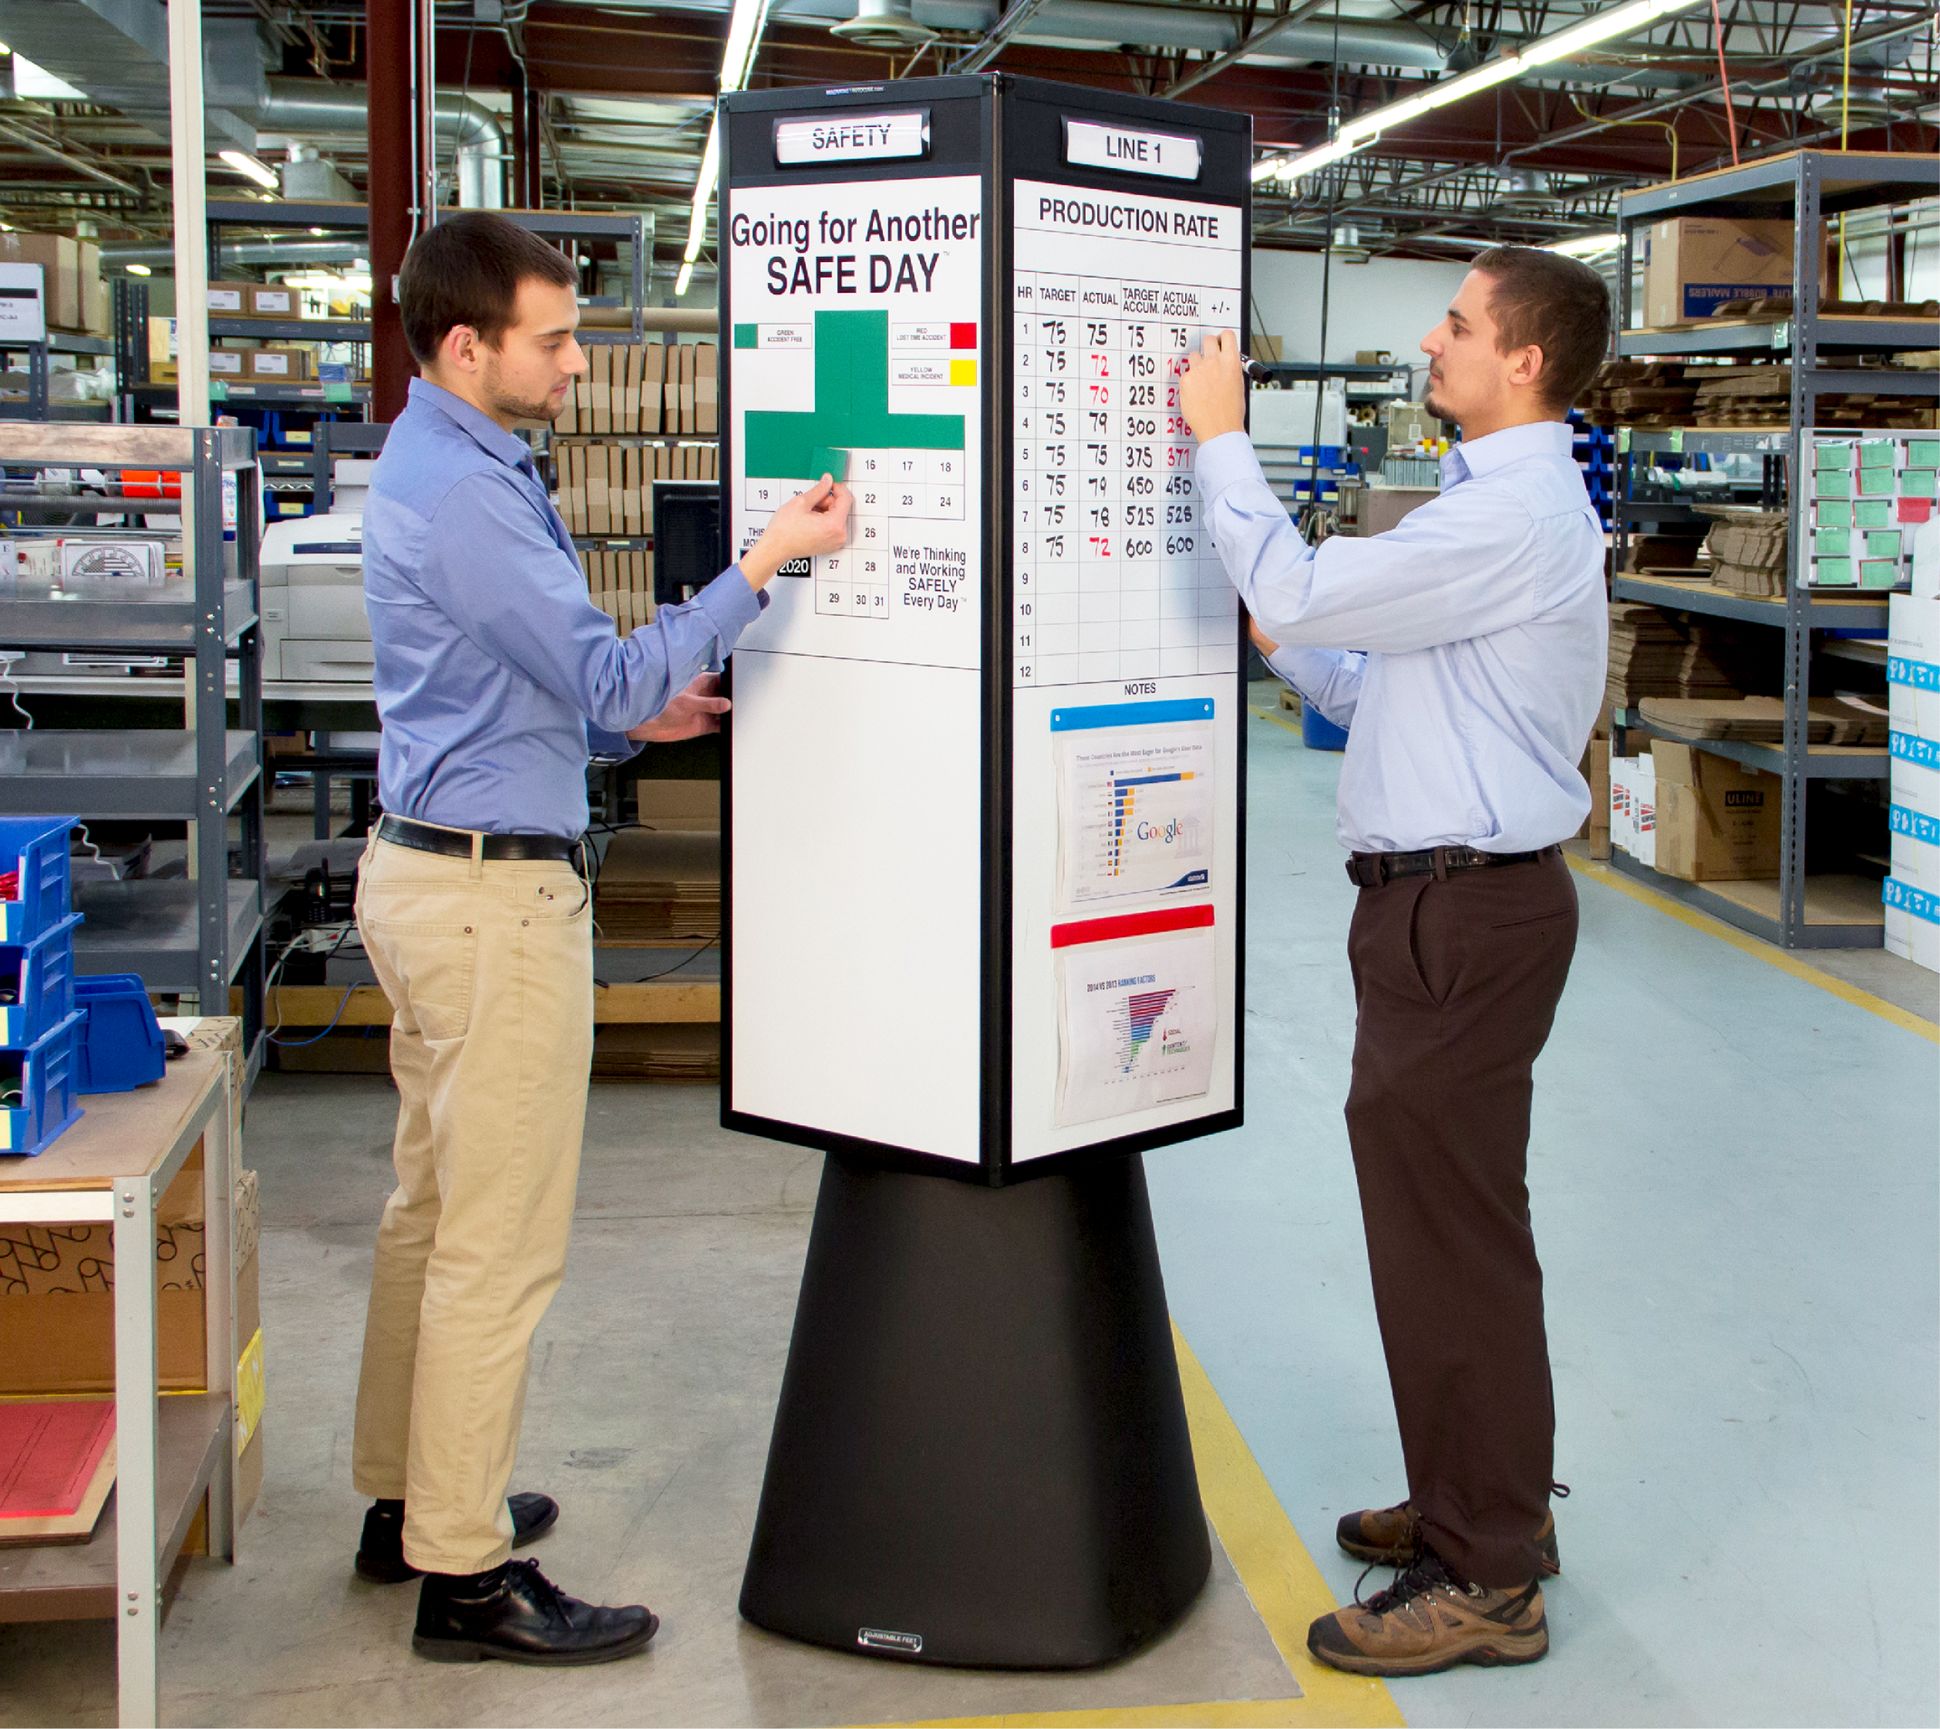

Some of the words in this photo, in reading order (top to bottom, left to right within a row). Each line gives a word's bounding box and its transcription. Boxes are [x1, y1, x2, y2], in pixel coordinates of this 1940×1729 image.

[812, 123, 891, 150] SAFETY
[1106, 136, 1148, 162] LINE
[1154, 143, 1162, 163] 1
[1039, 198, 1168, 234] PRODUCTION
[1174, 213, 1219, 239] RATE
[731, 213, 810, 253] Going
[819, 210, 857, 244] for
[865, 206, 980, 242] Another
[767, 255, 856, 295] SAFE
[869, 252, 939, 294] DAY
[1017, 286, 1033, 299] HR
[1040, 288, 1076, 302] TARGET
[1082, 291, 1118, 305] ACTUAL
[1122, 288, 1160, 301] TARGET
[1163, 291, 1199, 305] ACTUAL
[1688, 287, 1731, 298] MAILERS
[1122, 301, 1160, 314] ACCUM.
[1163, 304, 1199, 318] ACCUM.
[1023, 324, 1028, 334] 1
[1043, 321, 1066, 345] 75
[1087, 323, 1108, 346] 75
[1128, 325, 1145, 348] 75
[1170, 327, 1187, 348] 75
[1022, 355, 1029, 366] 2
[1046, 350, 1066, 373] 75
[1091, 354, 1109, 377] 72
[1128, 354, 1155, 378] 150
[1022, 386, 1029, 397] 3
[1045, 382, 1065, 403] 75
[1089, 385, 1109, 404] 70
[1129, 385, 1156, 406] 225
[1022, 417, 1029, 428] 4
[1046, 413, 1066, 435] 75
[1089, 411, 1108, 435] 79
[1127, 416, 1156, 437] 300
[1022, 448, 1029, 460] 5
[1046, 445, 1065, 466] 75
[1087, 444, 1108, 466] 75
[1126, 447, 1153, 468] 375
[1167, 447, 1190, 468] 371
[865, 459, 876, 470] 16
[902, 460, 913, 471] 17
[940, 462, 952, 473] 18
[1022, 479, 1029, 491] 6
[1046, 474, 1067, 496] 75
[1088, 476, 1107, 497] 79
[1127, 475, 1154, 497] 450
[1166, 477, 1192, 496] 450
[758, 489, 769, 500] 19
[865, 494, 876, 504] 22
[902, 495, 913, 506] 23
[940, 496, 952, 507] 24
[1022, 511, 1029, 522] 7
[1044, 505, 1066, 526] 75
[1091, 506, 1110, 528] 78
[1125, 505, 1155, 527] 525
[865, 528, 876, 538] 26
[1022, 542, 1029, 554] 8
[1046, 535, 1064, 558] 75
[1089, 536, 1111, 557] 72
[1125, 538, 1153, 558] 600
[1166, 536, 1194, 555] 600
[893, 545, 921, 560] We're
[923, 547, 966, 566] Thinking
[779, 559, 810, 574] 2020
[829, 560, 839, 570] 27
[865, 561, 876, 572] 28
[895, 562, 916, 575] and
[919, 563, 966, 581] Working
[908, 578, 957, 593] SAFELY
[1022, 573, 1029, 585] 9
[829, 593, 840, 603] 29
[856, 594, 867, 605] 30
[874, 596, 885, 607] 31
[903, 594, 934, 611] Every
[937, 596, 959, 613] Day
[1019, 604, 1032, 616] 10
[1019, 635, 1031, 646] 11
[1019, 666, 1032, 678] 12
[1124, 682, 1156, 695] NOTES
[1727, 791, 1762, 805] ULINE
[1137, 818, 1184, 844] Google
